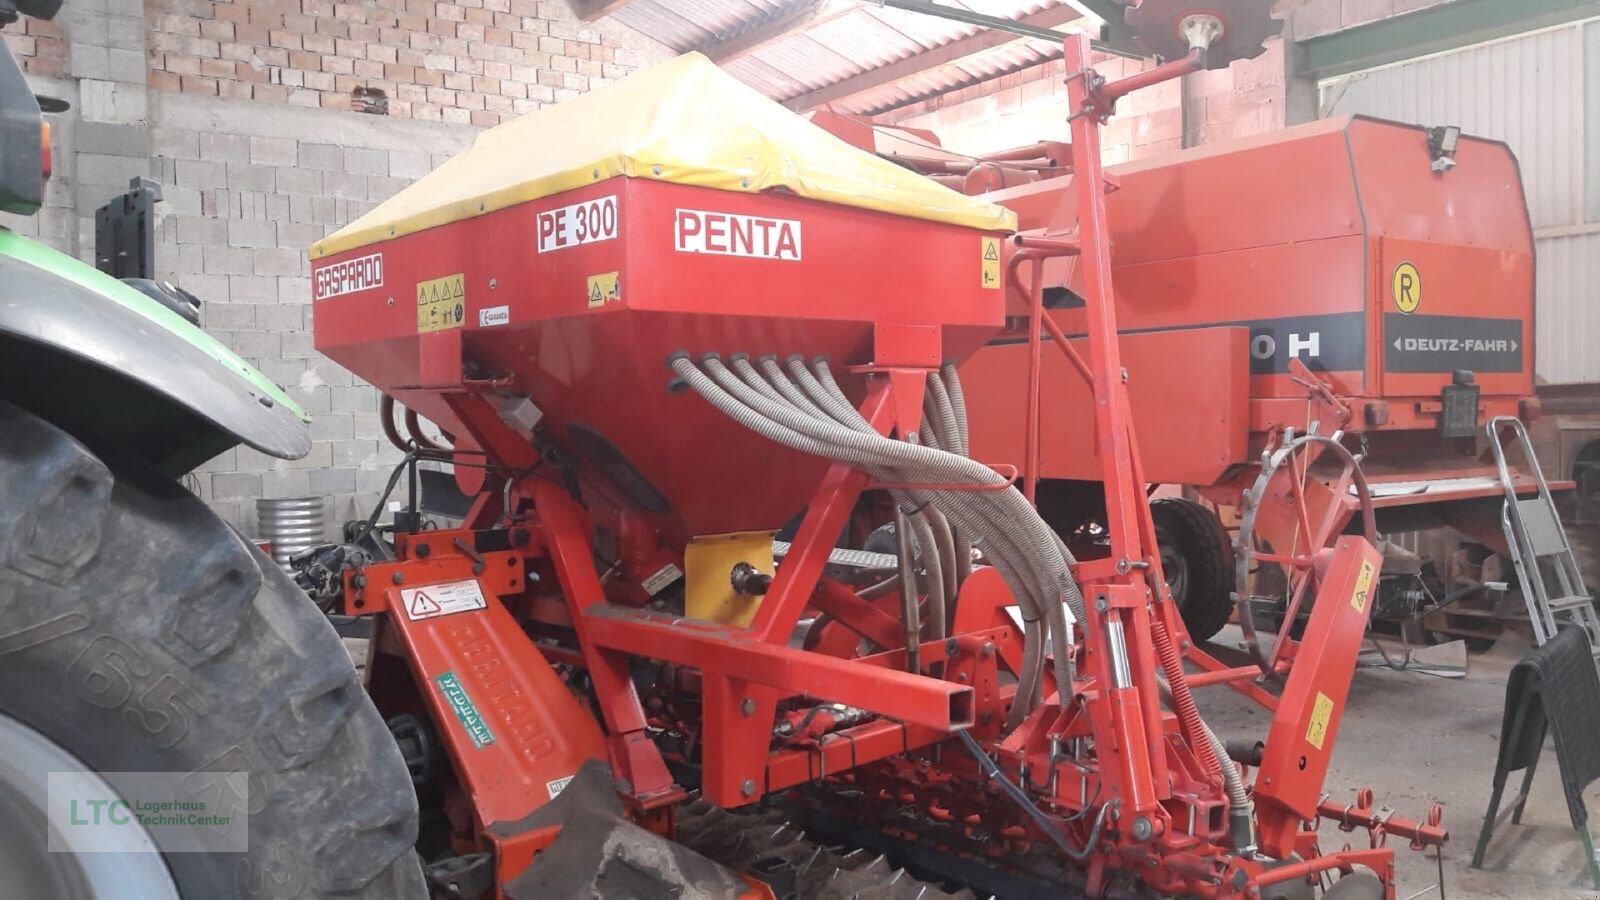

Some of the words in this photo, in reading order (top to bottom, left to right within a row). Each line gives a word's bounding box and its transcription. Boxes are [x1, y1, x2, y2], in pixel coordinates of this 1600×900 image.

[540, 209, 567, 249] PE
[576, 199, 615, 241] 300
[678, 211, 798, 257] PENTA
[316, 255, 382, 297] GASPARDO
[1400, 273, 1413, 303] R
[1289, 332, 1319, 357] H
[1404, 337, 1508, 352] DEUTZ-FAHR
